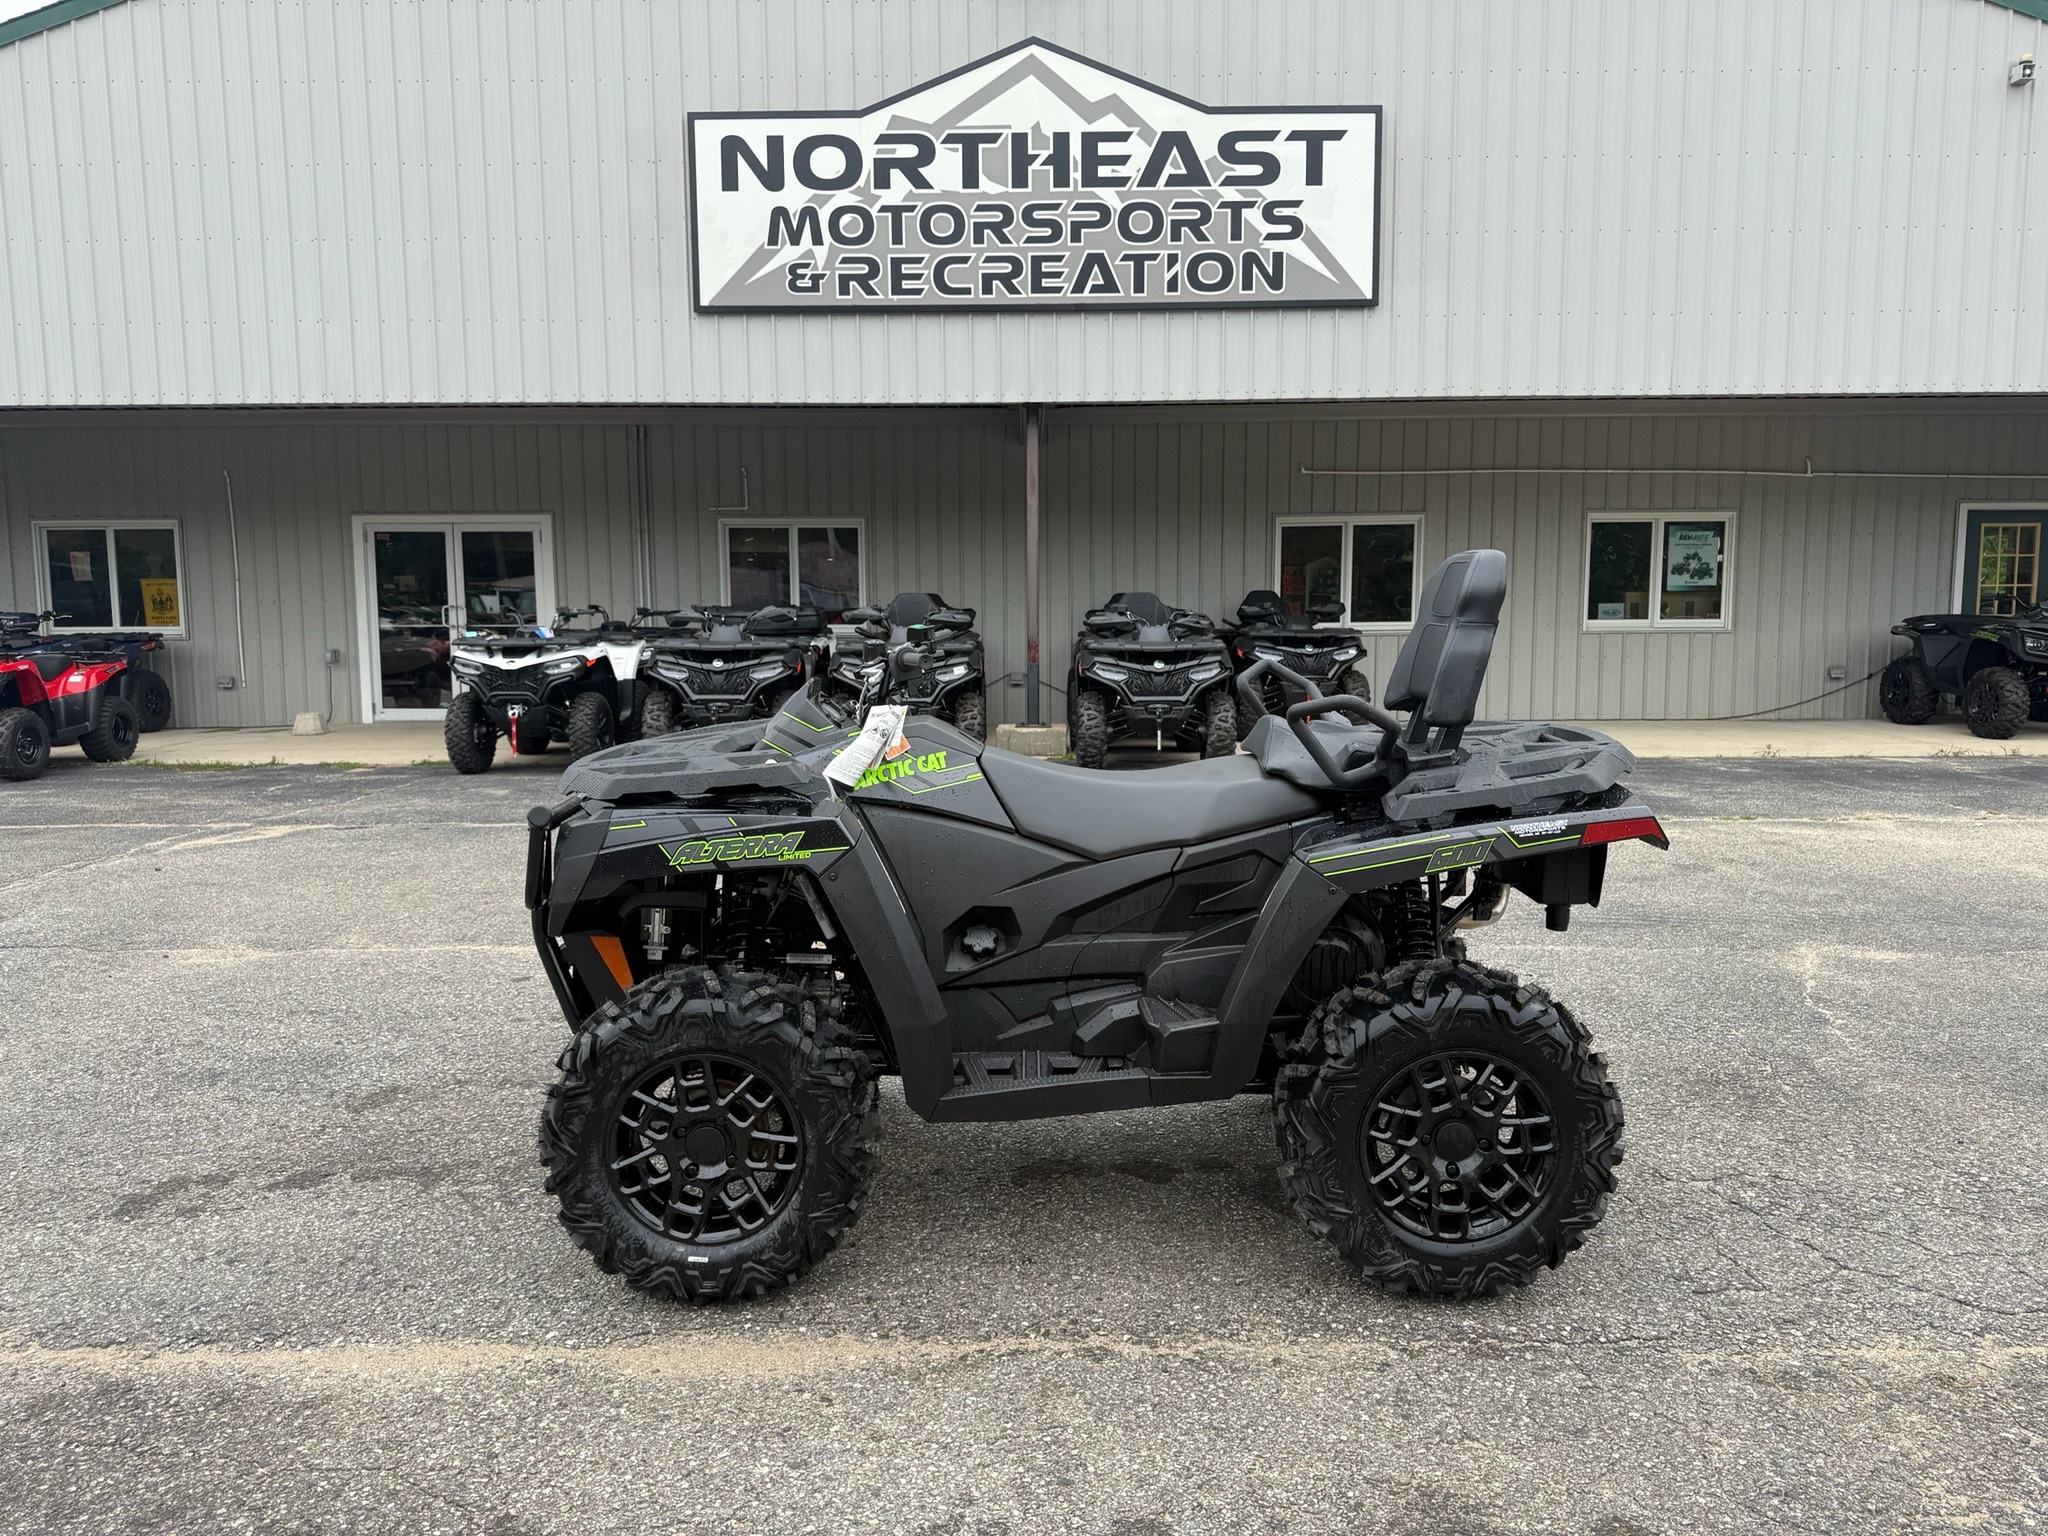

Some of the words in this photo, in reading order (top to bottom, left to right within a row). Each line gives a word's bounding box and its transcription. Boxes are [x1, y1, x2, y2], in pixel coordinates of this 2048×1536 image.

[720, 129, 1349, 192] NORTHEAST
[766, 199, 1305, 247] MOTORSPORTS
[854, 758, 915, 791] ARCTIC
[916, 750, 947, 772] CAT
[669, 830, 806, 866] ALTERRA
[777, 851, 812, 862] LIMITED
[1425, 837, 1497, 873] 600
